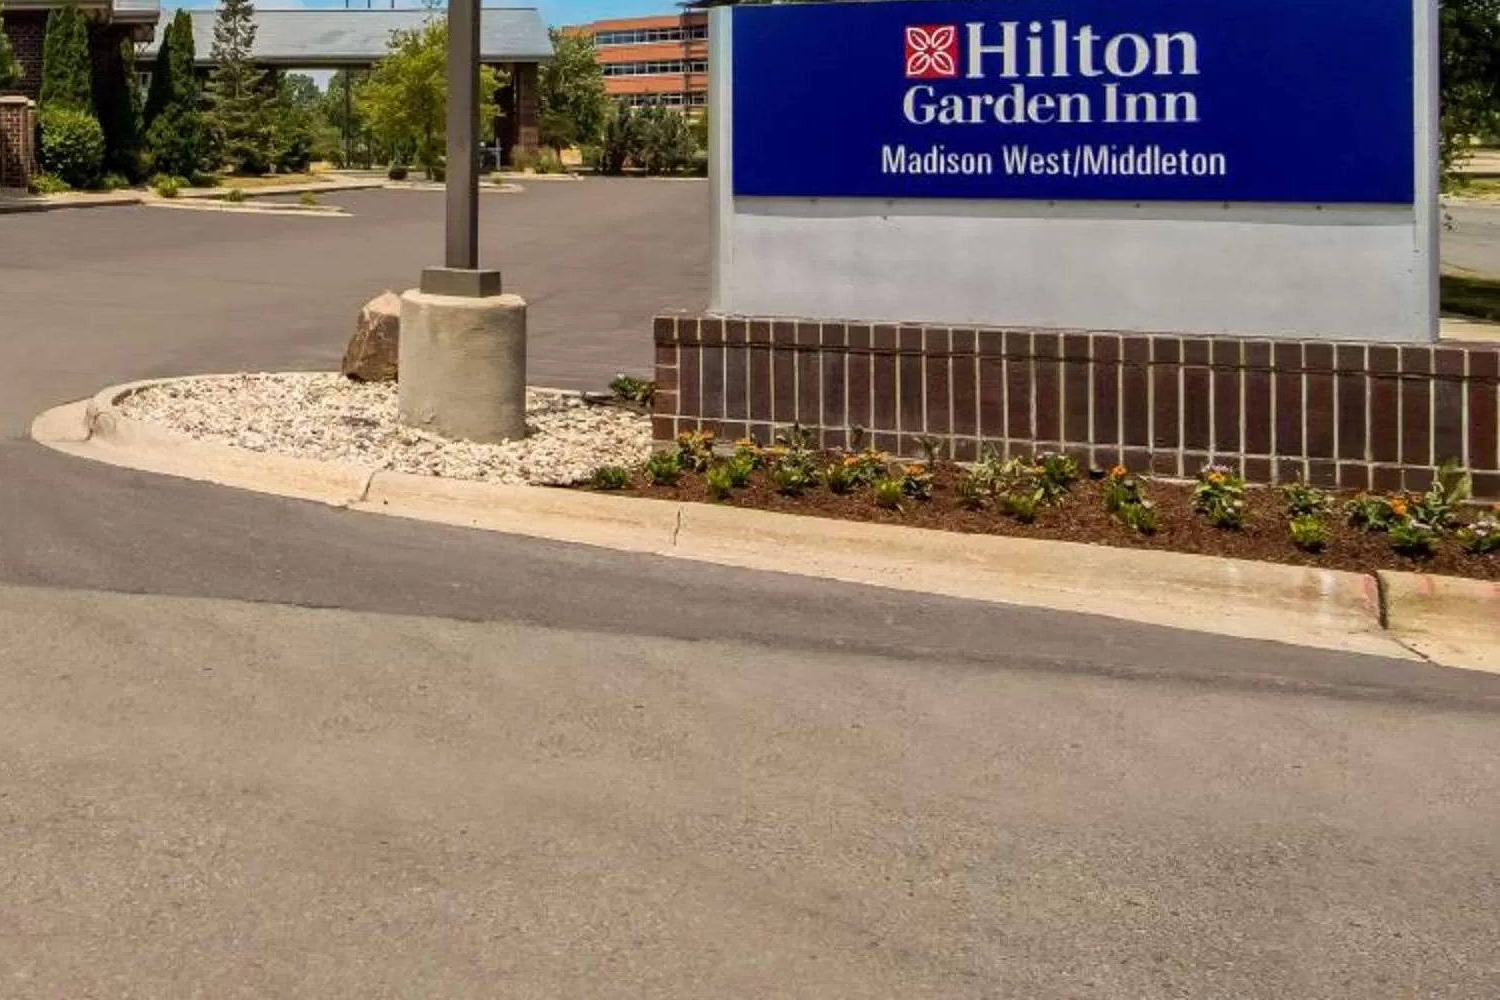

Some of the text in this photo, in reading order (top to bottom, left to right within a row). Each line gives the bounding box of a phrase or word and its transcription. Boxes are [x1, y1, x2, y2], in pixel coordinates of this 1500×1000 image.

[965, 20, 1200, 79] Hilton
[902, 83, 1199, 125] Garden Inn
[880, 145, 1226, 177] Madison West/Middleton
